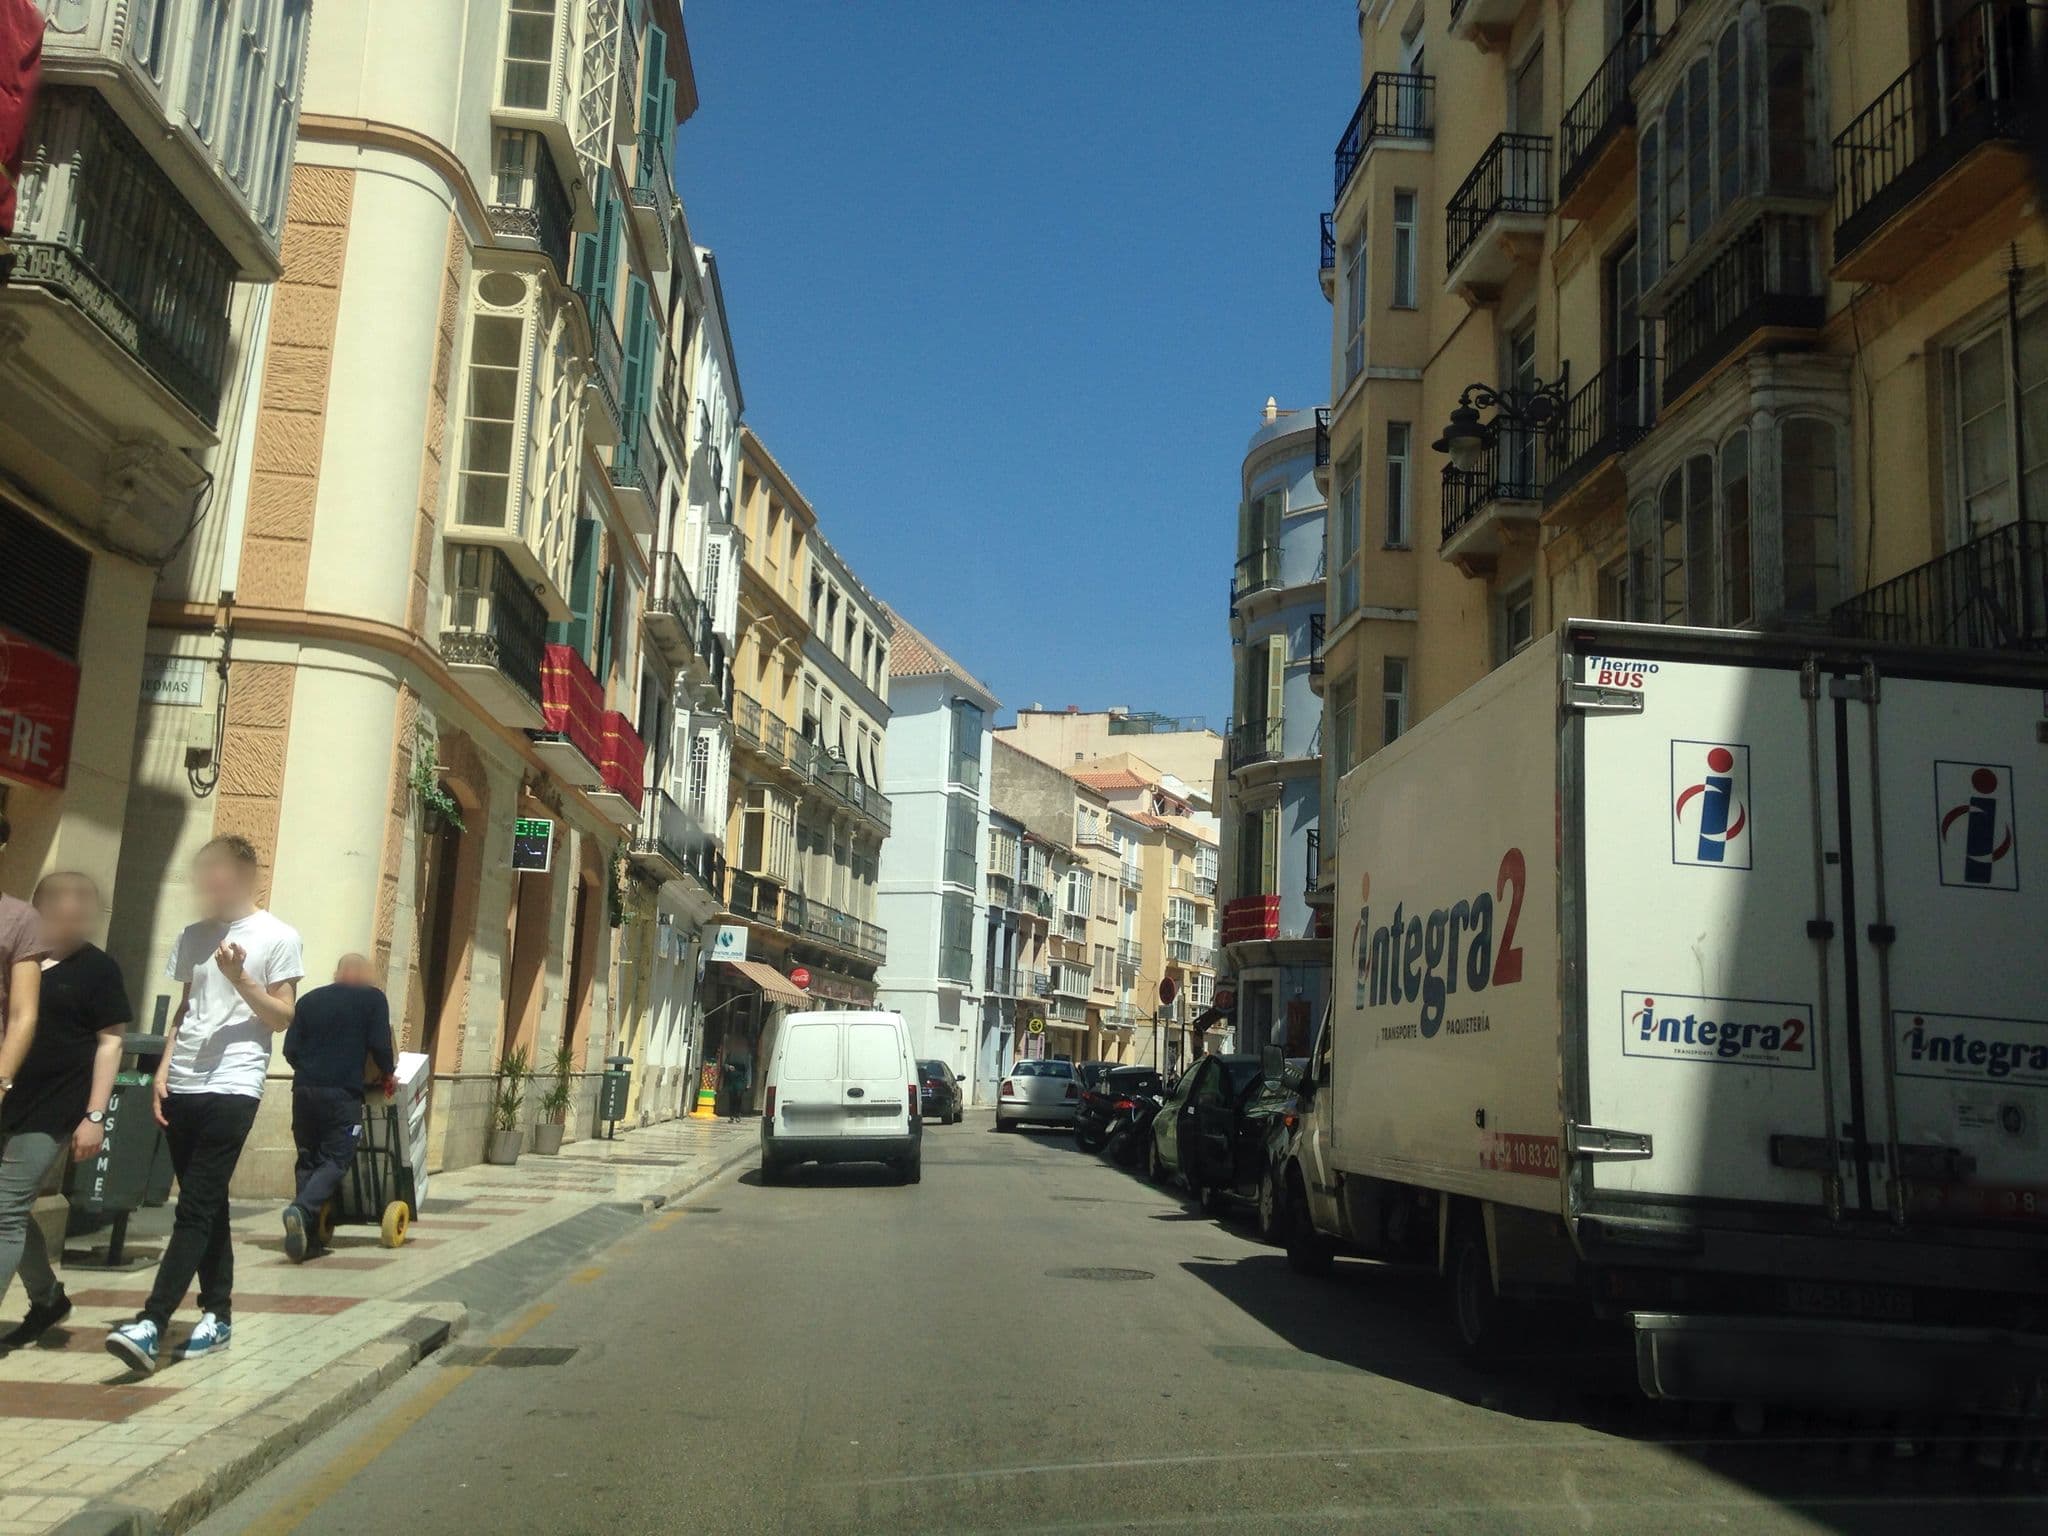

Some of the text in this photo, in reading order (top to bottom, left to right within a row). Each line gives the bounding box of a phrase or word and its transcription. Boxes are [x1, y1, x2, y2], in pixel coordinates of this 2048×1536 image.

[1589, 656, 1659, 674] Thermo
[1598, 671, 1643, 689] BUS
[1353, 847, 1526, 1039] integra2
[1381, 1024, 1417, 1041] TRANSPORTE
[1638, 997, 1806, 1058] integra2
[94, 1093, 119, 1192] ÚSAME
[1513, 1142, 1526, 1166] 10
[1528, 1143, 1541, 1167] 83
[1544, 1145, 1557, 1169] 20
